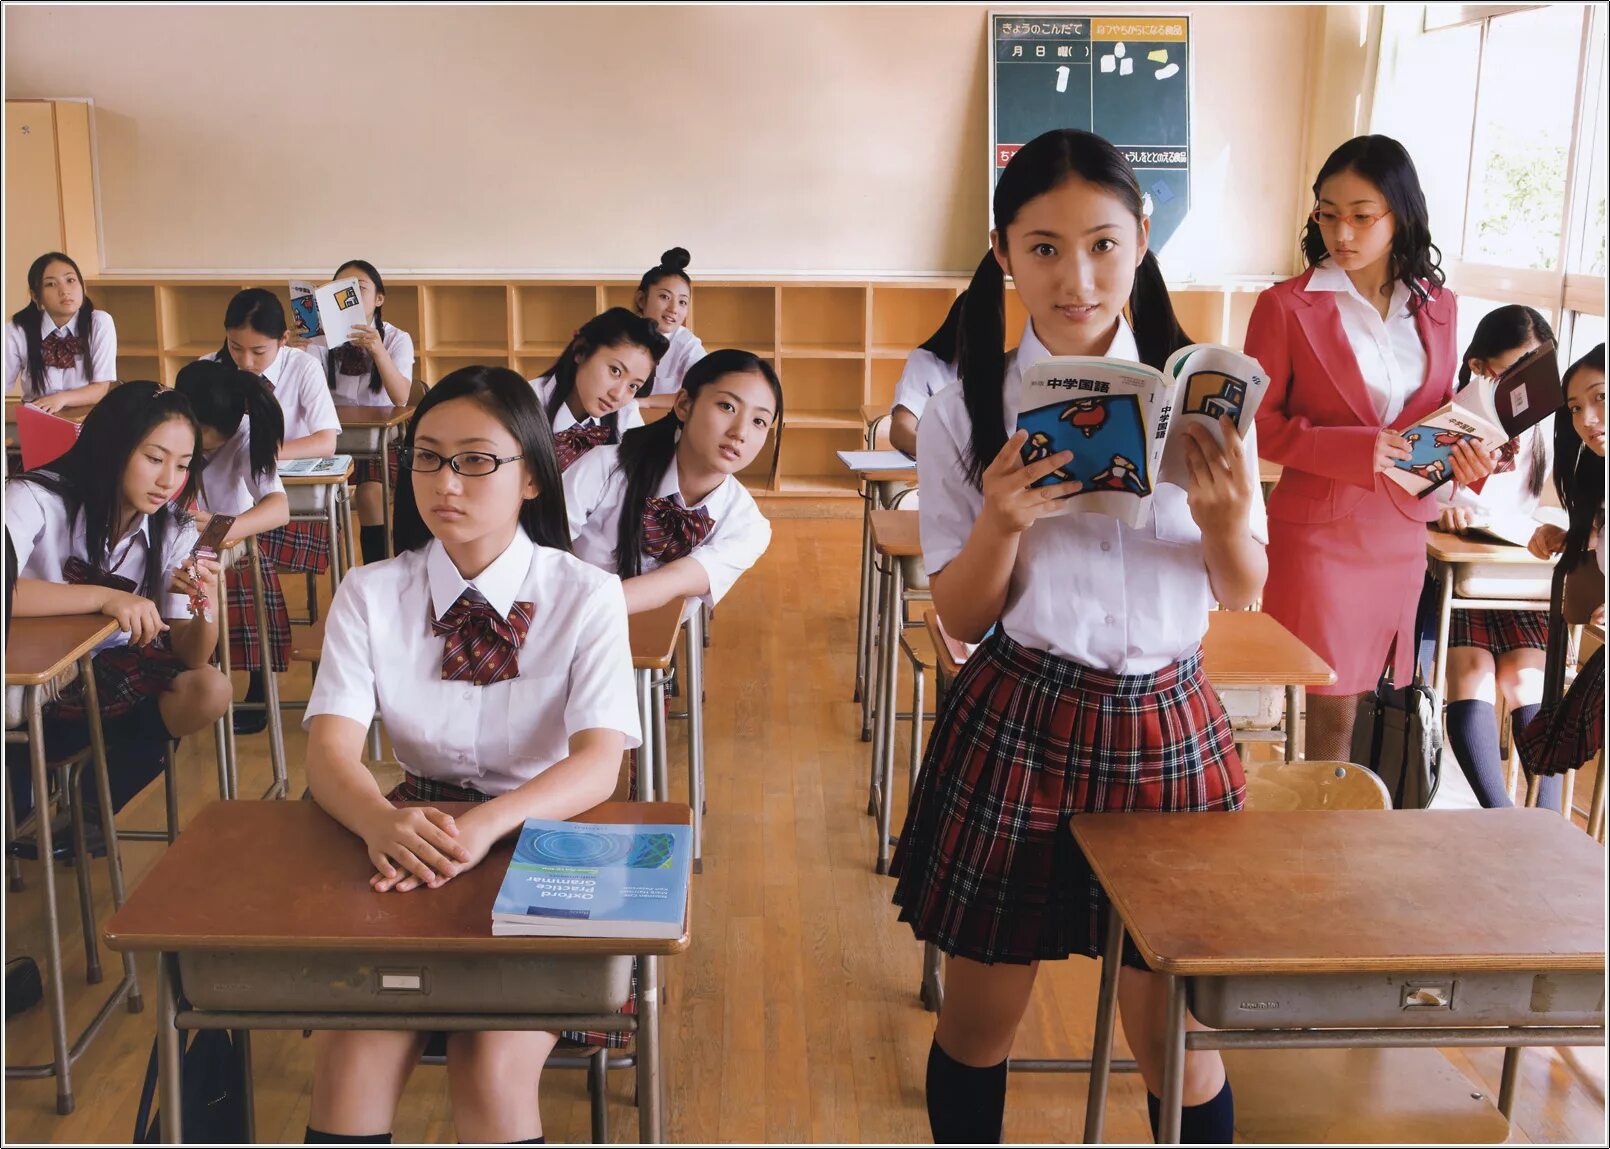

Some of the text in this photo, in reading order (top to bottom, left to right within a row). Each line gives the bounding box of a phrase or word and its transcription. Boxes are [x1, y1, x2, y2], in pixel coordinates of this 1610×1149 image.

[1001, 22, 1083, 36] きょうのこんだて
[1012, 45, 1023, 57] 月
[1036, 45, 1046, 57] 日
[1047, 377, 1111, 394] 中学国語
[1155, 405, 1172, 439] 中学国語
[526, 876, 597, 886] Grammar
[535, 882, 596, 894] Practice
[540, 890, 594, 900] Oxford
